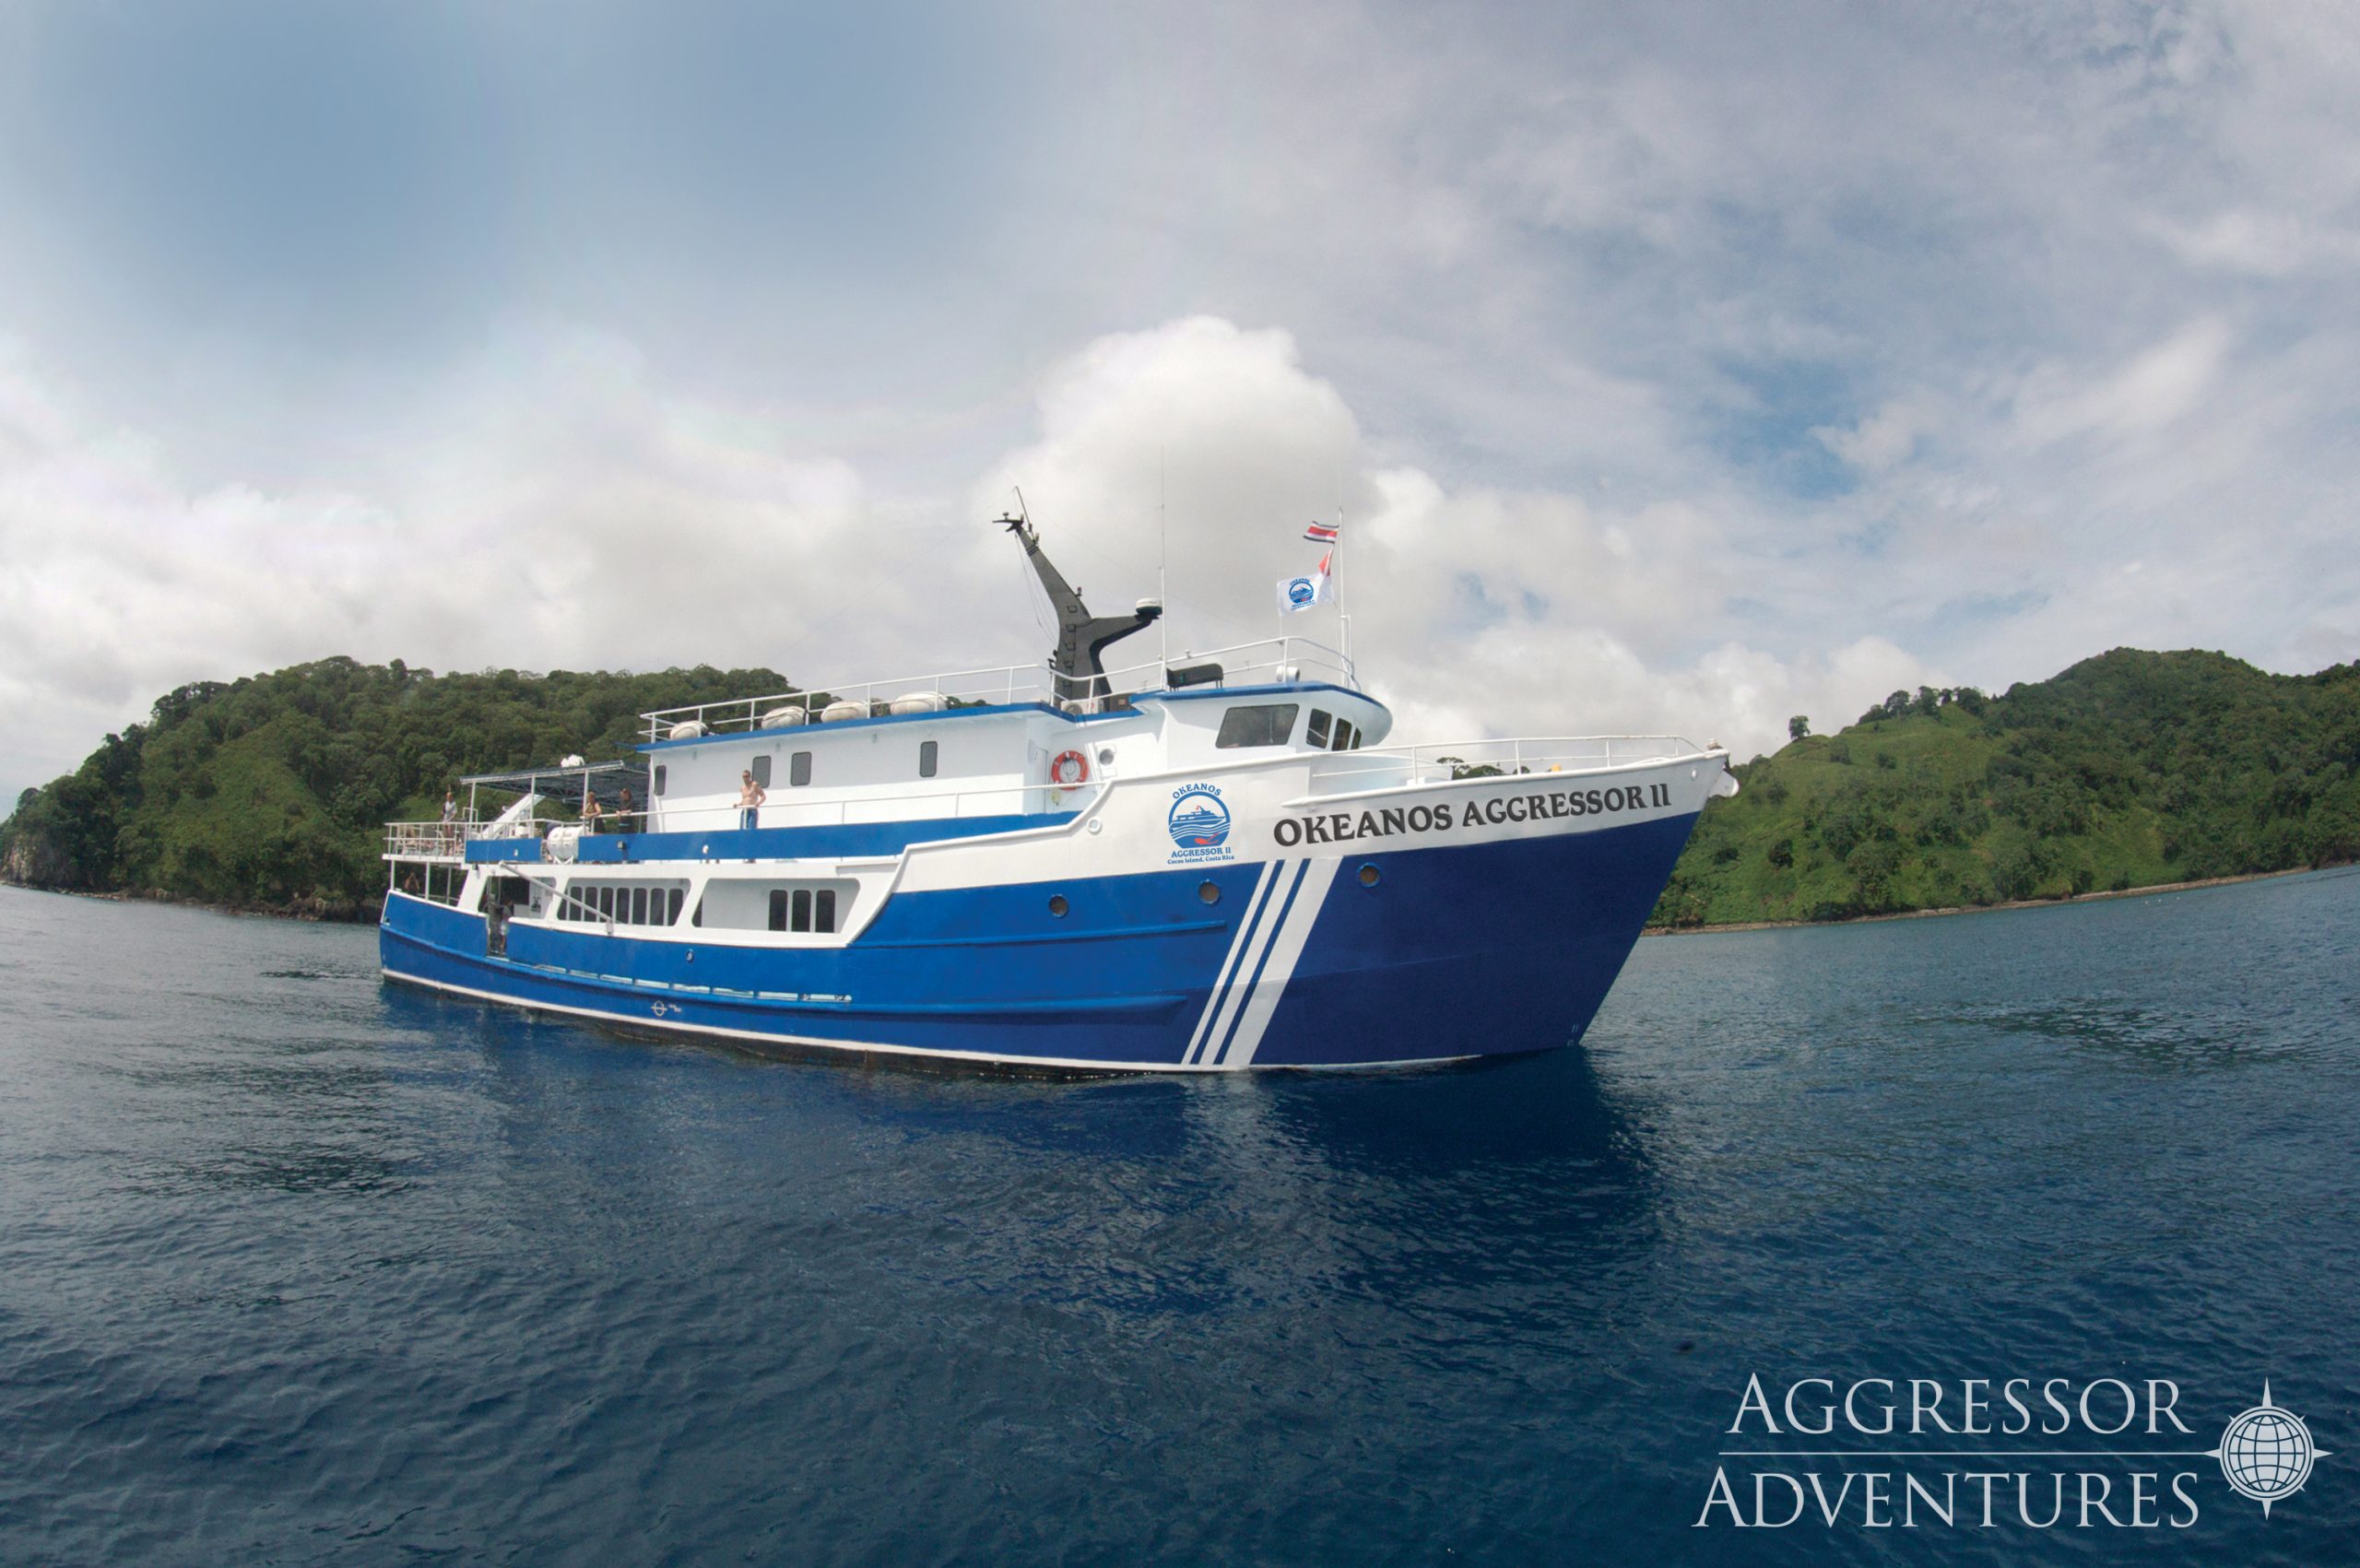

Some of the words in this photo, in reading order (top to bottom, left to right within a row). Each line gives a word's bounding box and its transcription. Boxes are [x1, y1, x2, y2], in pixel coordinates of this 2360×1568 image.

[1173, 784, 1221, 799] OKEANOS
[1273, 805, 1453, 847] OKEANOS
[1463, 786, 1648, 828] AGGRESSOR
[1650, 784, 1672, 808] II
[1172, 847, 1223, 857] AGGRESSOR
